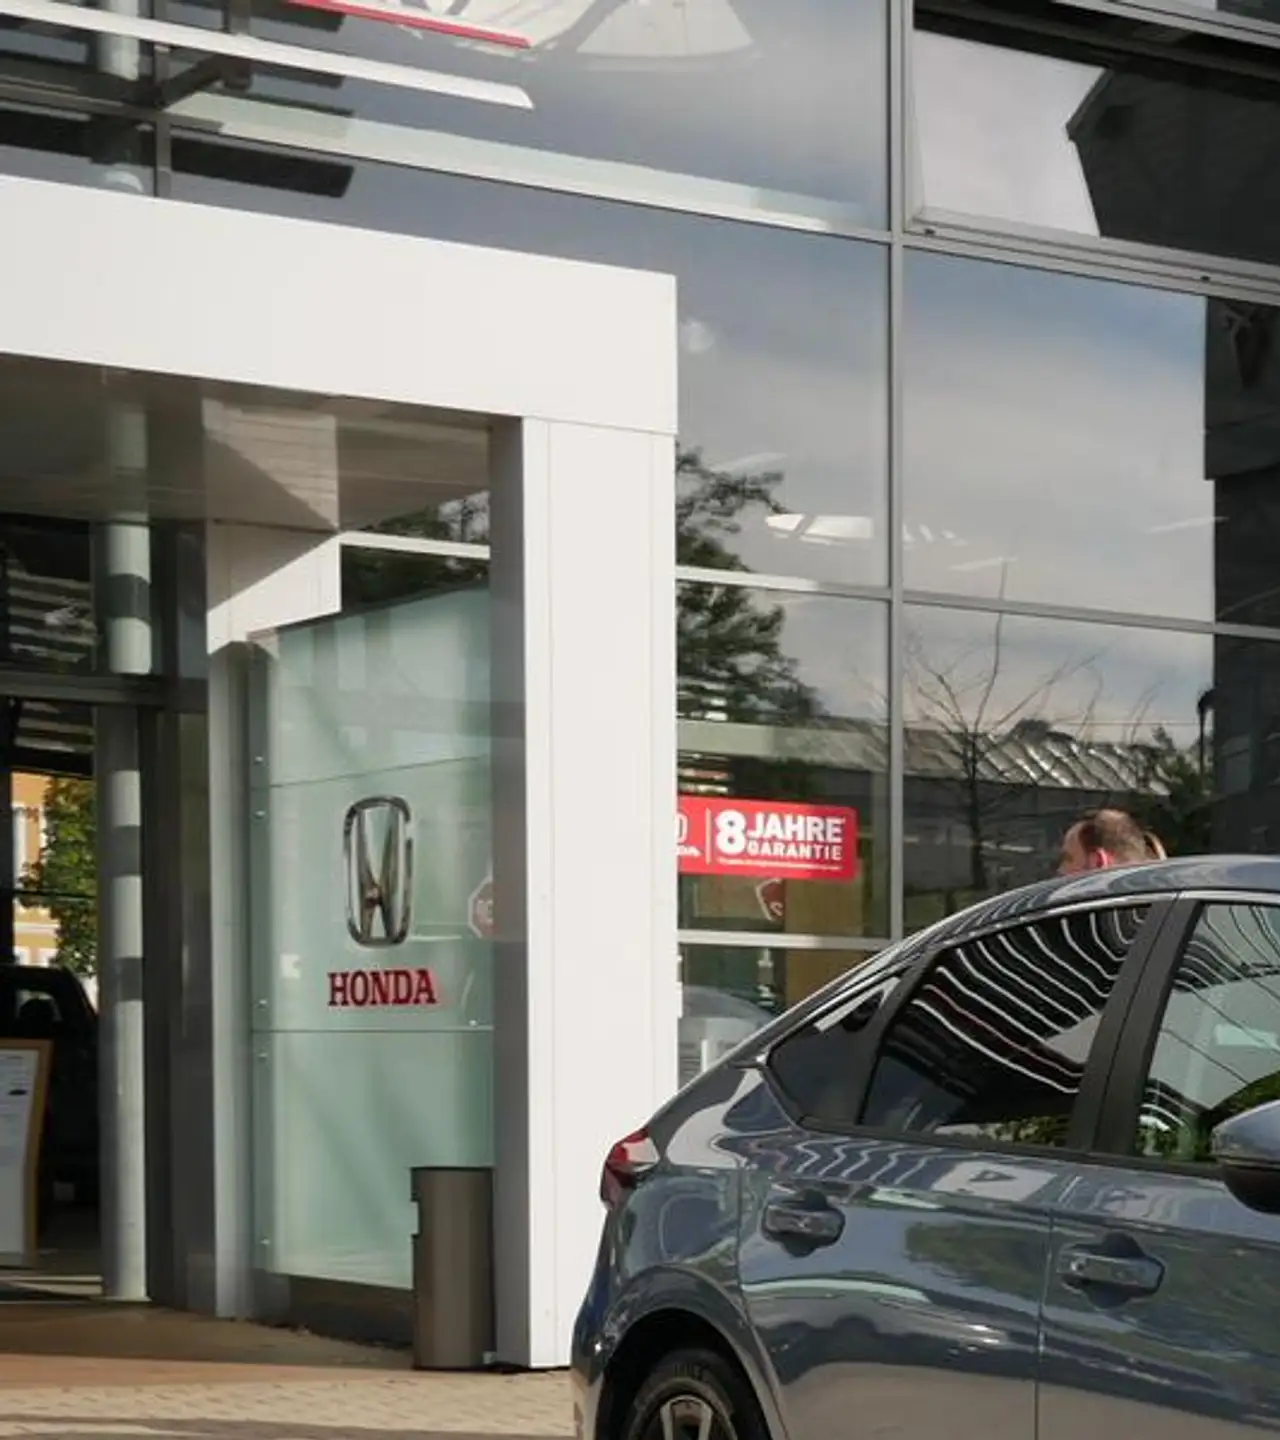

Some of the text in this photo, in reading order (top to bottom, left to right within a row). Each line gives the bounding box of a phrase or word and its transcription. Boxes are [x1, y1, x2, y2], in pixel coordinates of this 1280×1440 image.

[715, 808, 747, 855] 8
[747, 839, 843, 861] GARANTIE
[327, 968, 437, 1007] HONDA
